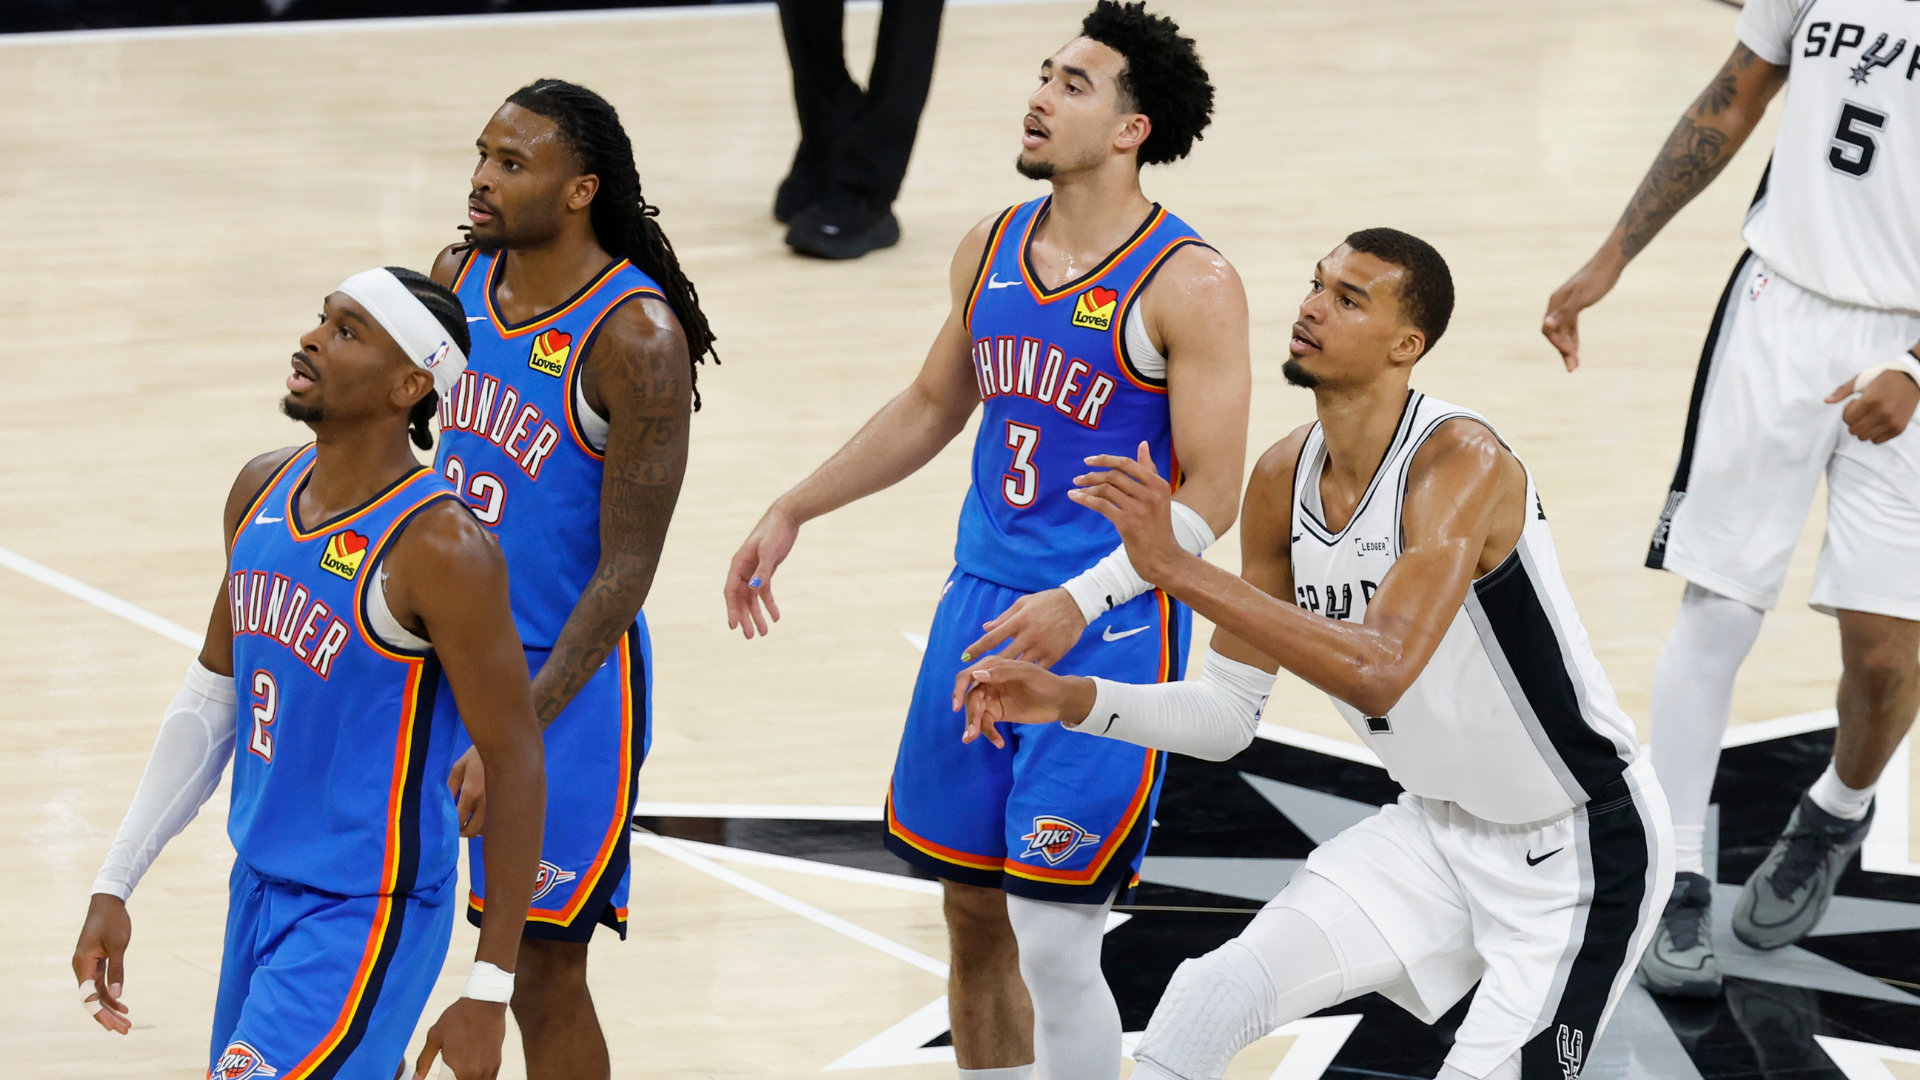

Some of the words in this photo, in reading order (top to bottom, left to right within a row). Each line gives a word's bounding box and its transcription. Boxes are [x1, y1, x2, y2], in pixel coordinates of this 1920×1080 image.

[1826, 99, 1889, 180] 5
[440, 370, 560, 481] HUNDER
[972, 336, 1117, 430] HUNDER
[637, 415, 673, 446] 75
[1003, 419, 1041, 508] 3
[1361, 542, 1386, 551] LEDGER
[229, 569, 350, 681] HUNDER
[249, 669, 278, 764] 2
[1030, 829, 1072, 849] OKC
[216, 1054, 251, 1072] OKC
